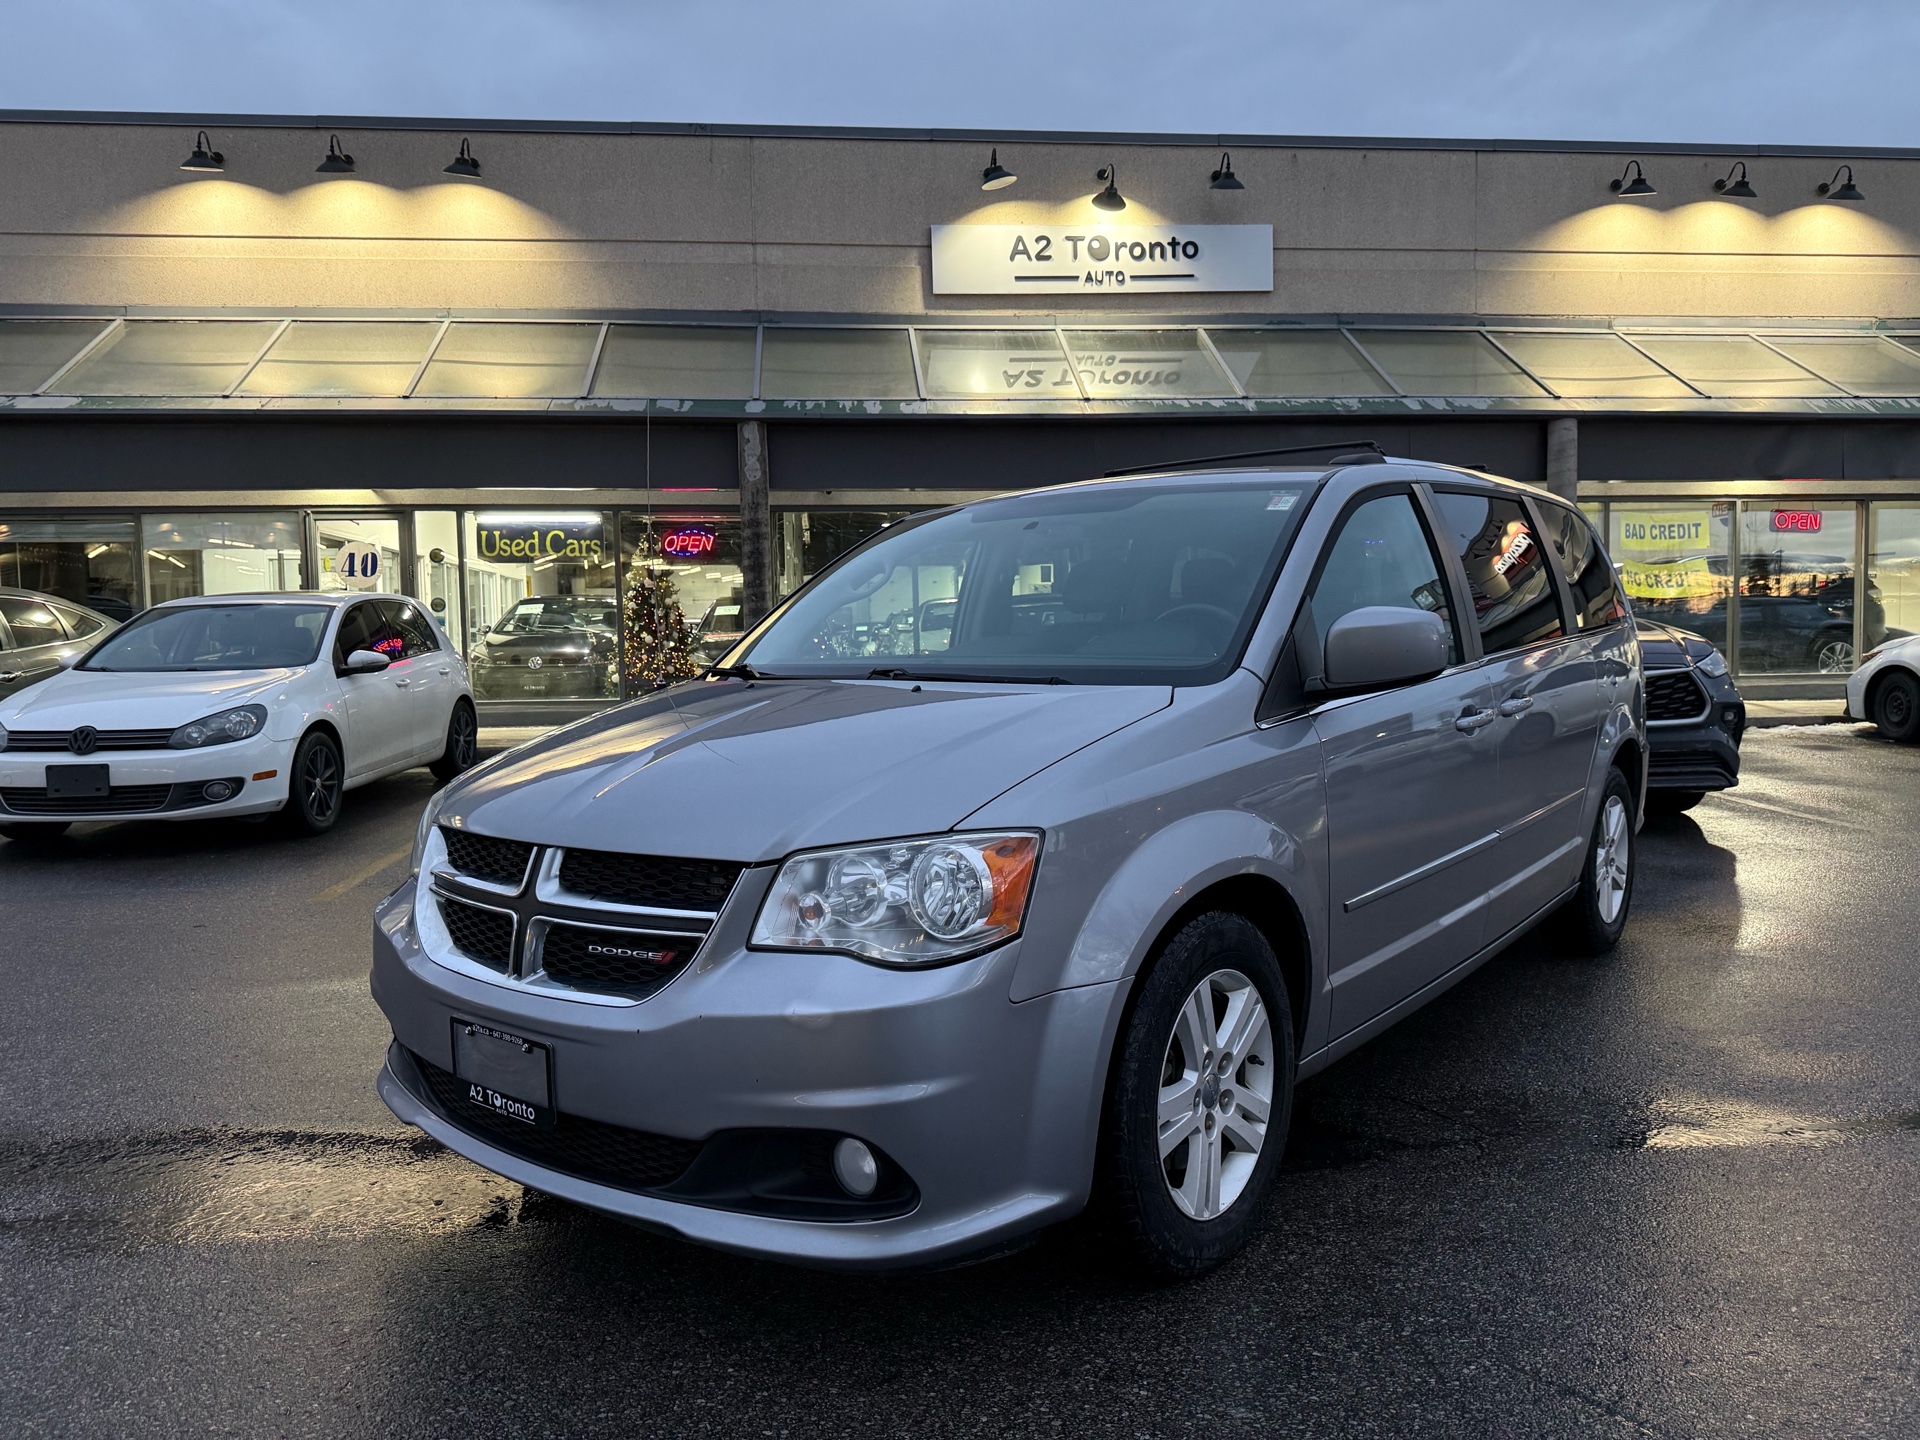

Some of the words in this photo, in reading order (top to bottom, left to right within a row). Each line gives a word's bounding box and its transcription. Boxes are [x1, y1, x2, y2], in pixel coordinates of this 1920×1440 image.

[1009, 235, 1053, 261] A2
[1084, 270, 1126, 285] AUTO
[1774, 512, 1820, 530] OPEN
[1624, 522, 1646, 540] BAD
[1649, 522, 1702, 540] CREDIT
[479, 530, 541, 557] Used
[545, 530, 601, 557] Cars
[664, 535, 714, 552] OPEN
[340, 551, 379, 578] 40
[588, 945, 663, 961] DODGE
[469, 1084, 484, 1101] A2
[496, 1107, 508, 1116] AUTO
